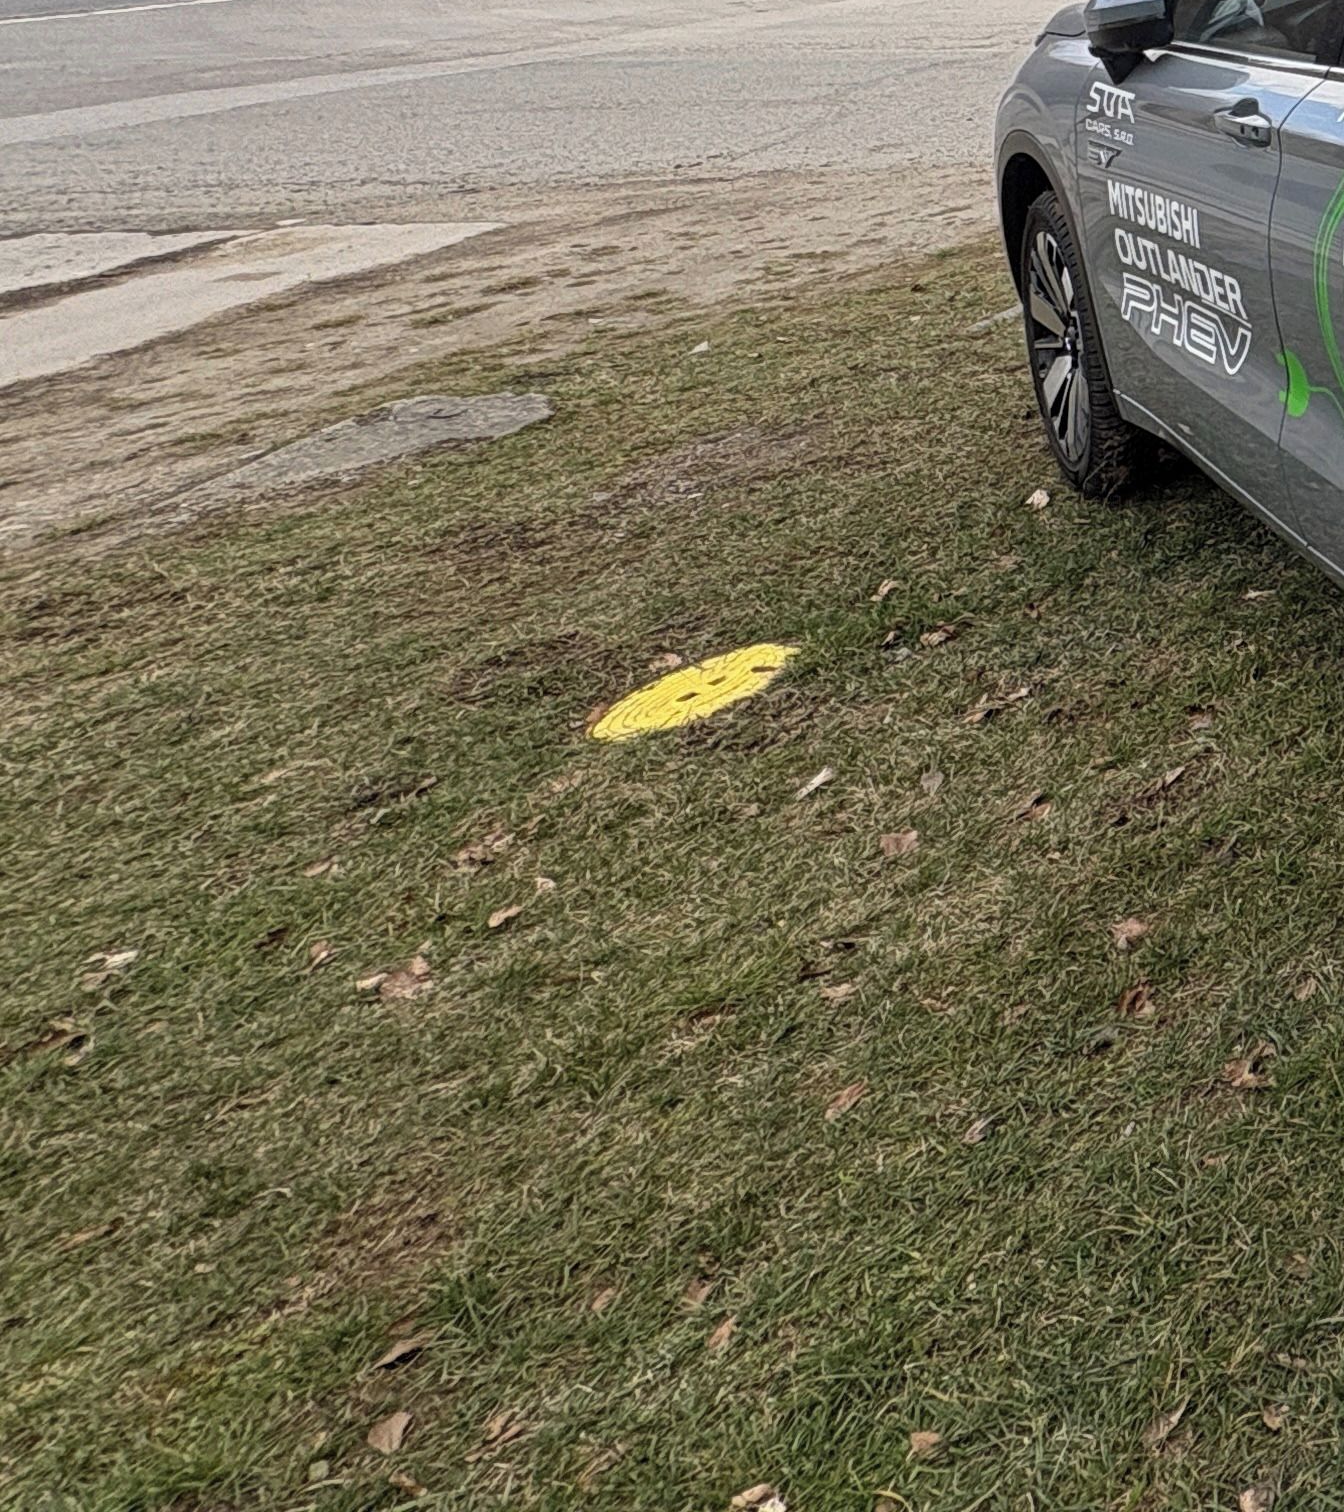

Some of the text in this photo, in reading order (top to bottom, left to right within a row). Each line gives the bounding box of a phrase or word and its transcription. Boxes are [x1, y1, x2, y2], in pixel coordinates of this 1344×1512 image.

[1107, 179, 1200, 249] MITSUBISHI
[1114, 227, 1248, 320] OUTLANDER
[1121, 271, 1252, 375] PHEV
